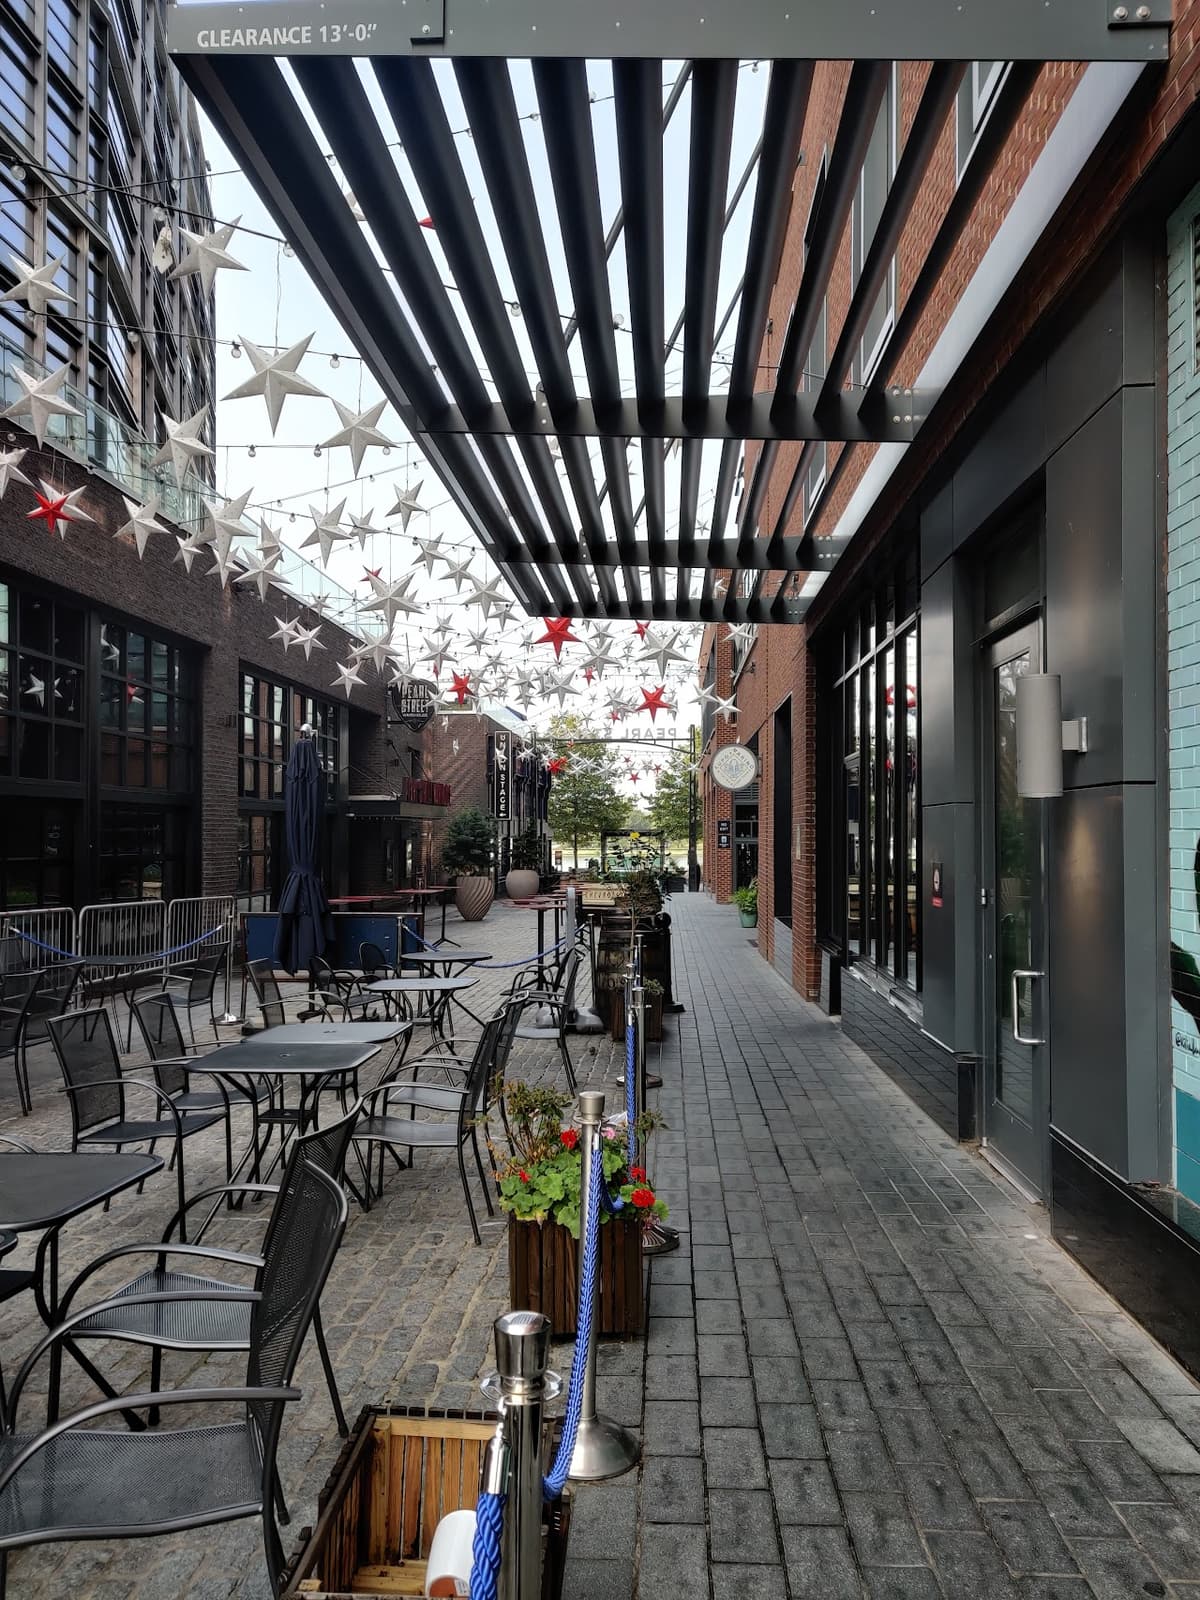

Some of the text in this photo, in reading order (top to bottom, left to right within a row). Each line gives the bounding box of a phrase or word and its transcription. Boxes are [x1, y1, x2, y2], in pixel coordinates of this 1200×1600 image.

[197, 26, 312, 48] CLEARANCE
[401, 684, 429, 699] PEARL
[401, 699, 429, 713] STREET
